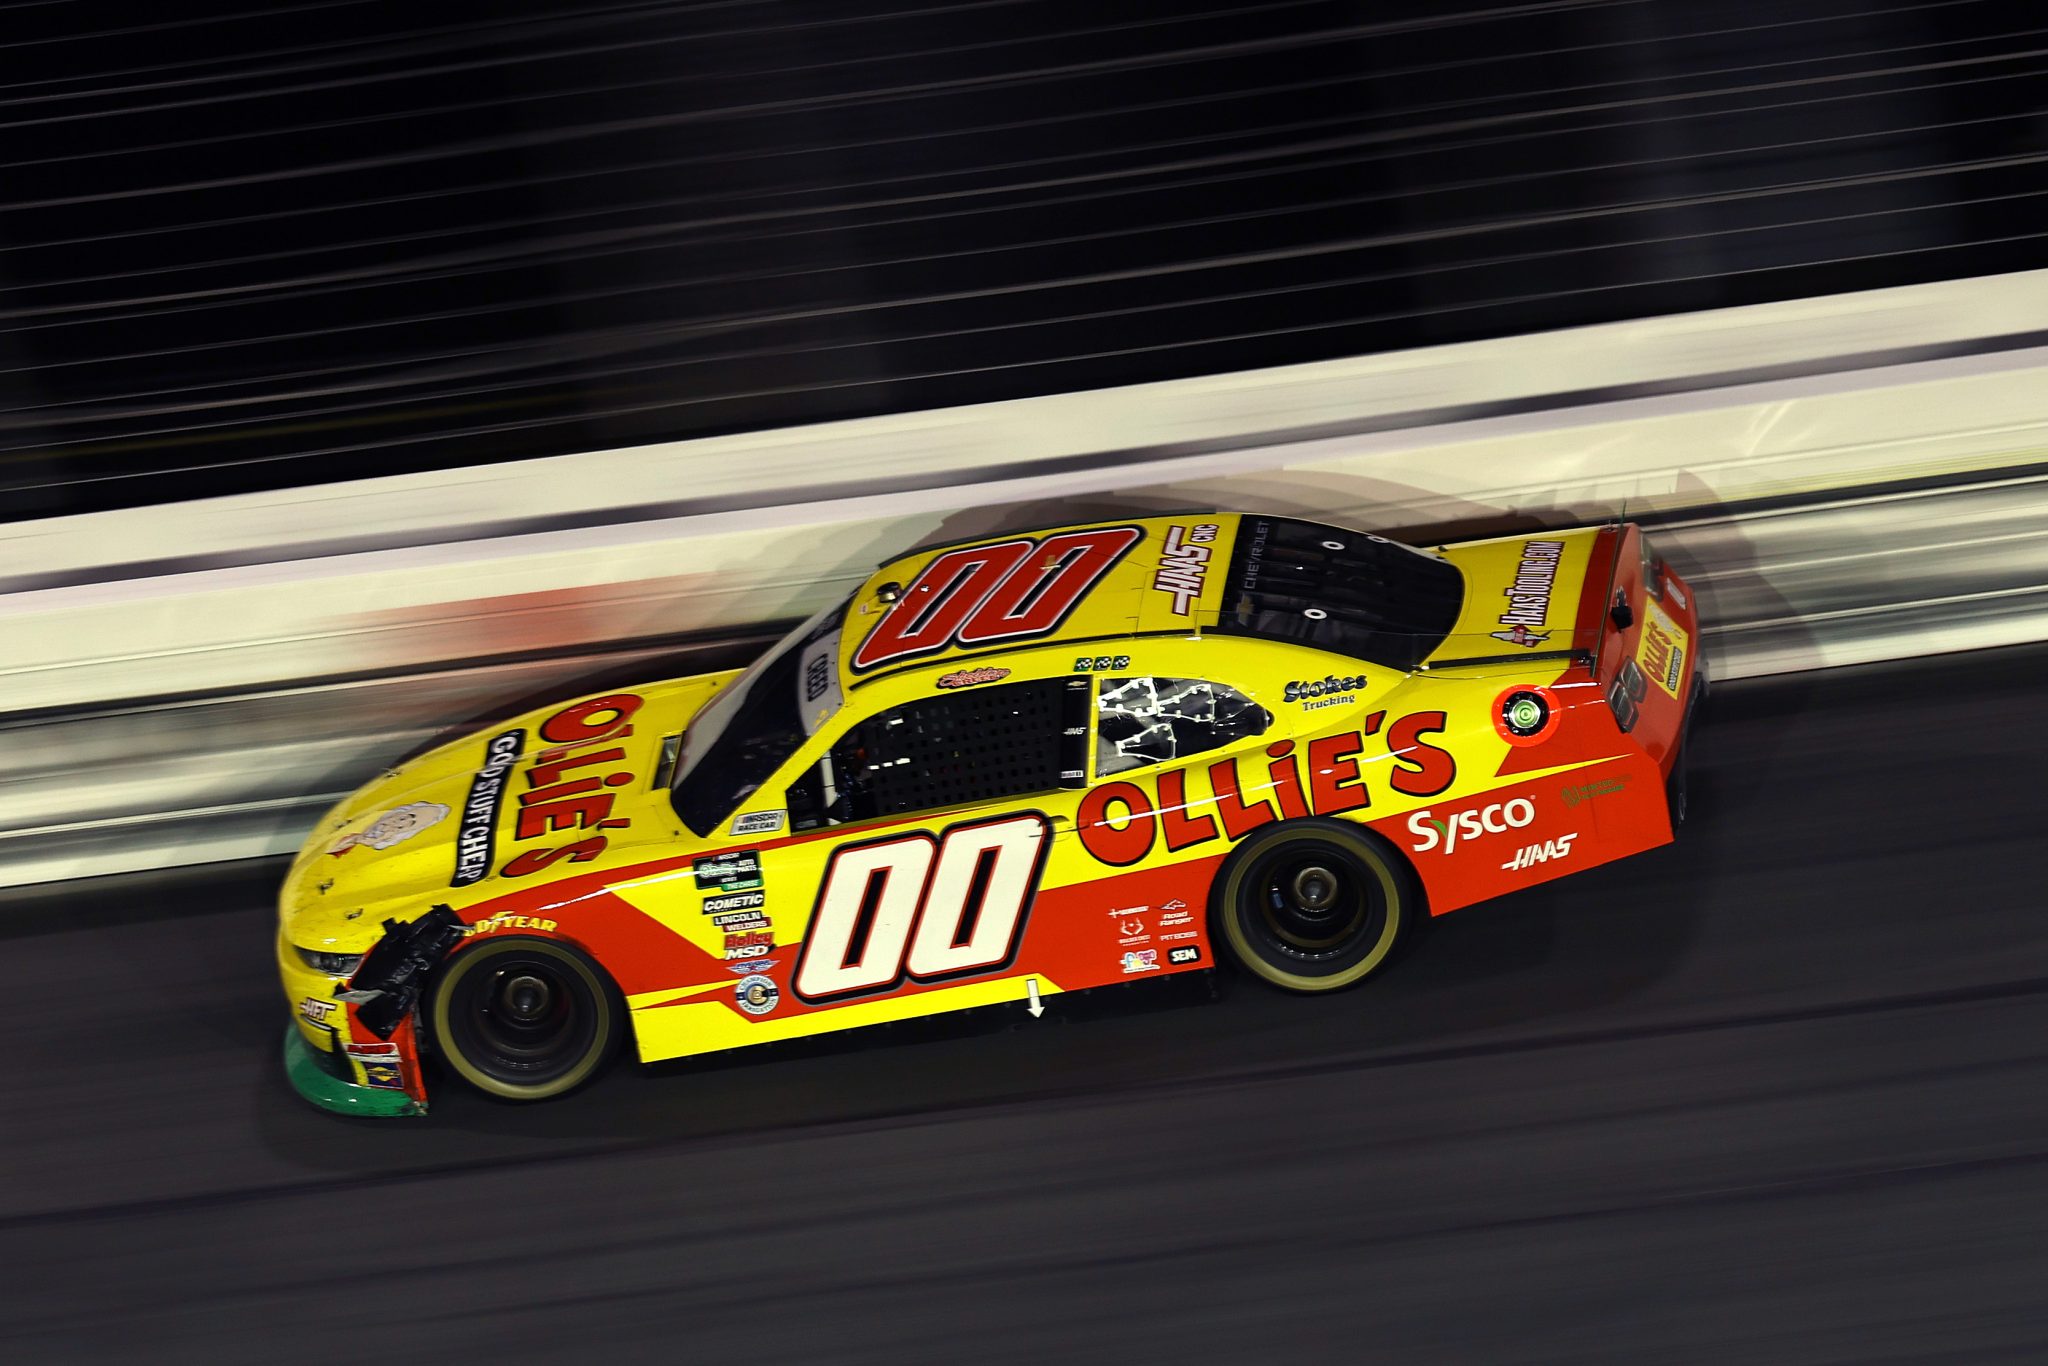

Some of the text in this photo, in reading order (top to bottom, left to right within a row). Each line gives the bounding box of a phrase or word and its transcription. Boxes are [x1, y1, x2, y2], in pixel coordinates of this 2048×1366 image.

[1189, 524, 1219, 543] CNC
[1243, 520, 1270, 590] CHEVROLET
[1152, 525, 1213, 616] HAAS
[851, 525, 1145, 673] 00
[1283, 675, 1367, 703] Stokes
[1303, 695, 1355, 711] Trucking
[467, 778, 502, 824] STUFF
[759, 821, 776, 829] CAR
[1501, 833, 1578, 871] HAAS
[704, 894, 764, 911] COMETIC
[793, 815, 1050, 1003] 00
[715, 911, 761, 925] LINCOLN
[1163, 911, 1189, 919] Road
[727, 920, 768, 931] WELDERS
[725, 931, 774, 949] Holley
[725, 945, 769, 960] MSD
[1171, 948, 1198, 962] SEM
